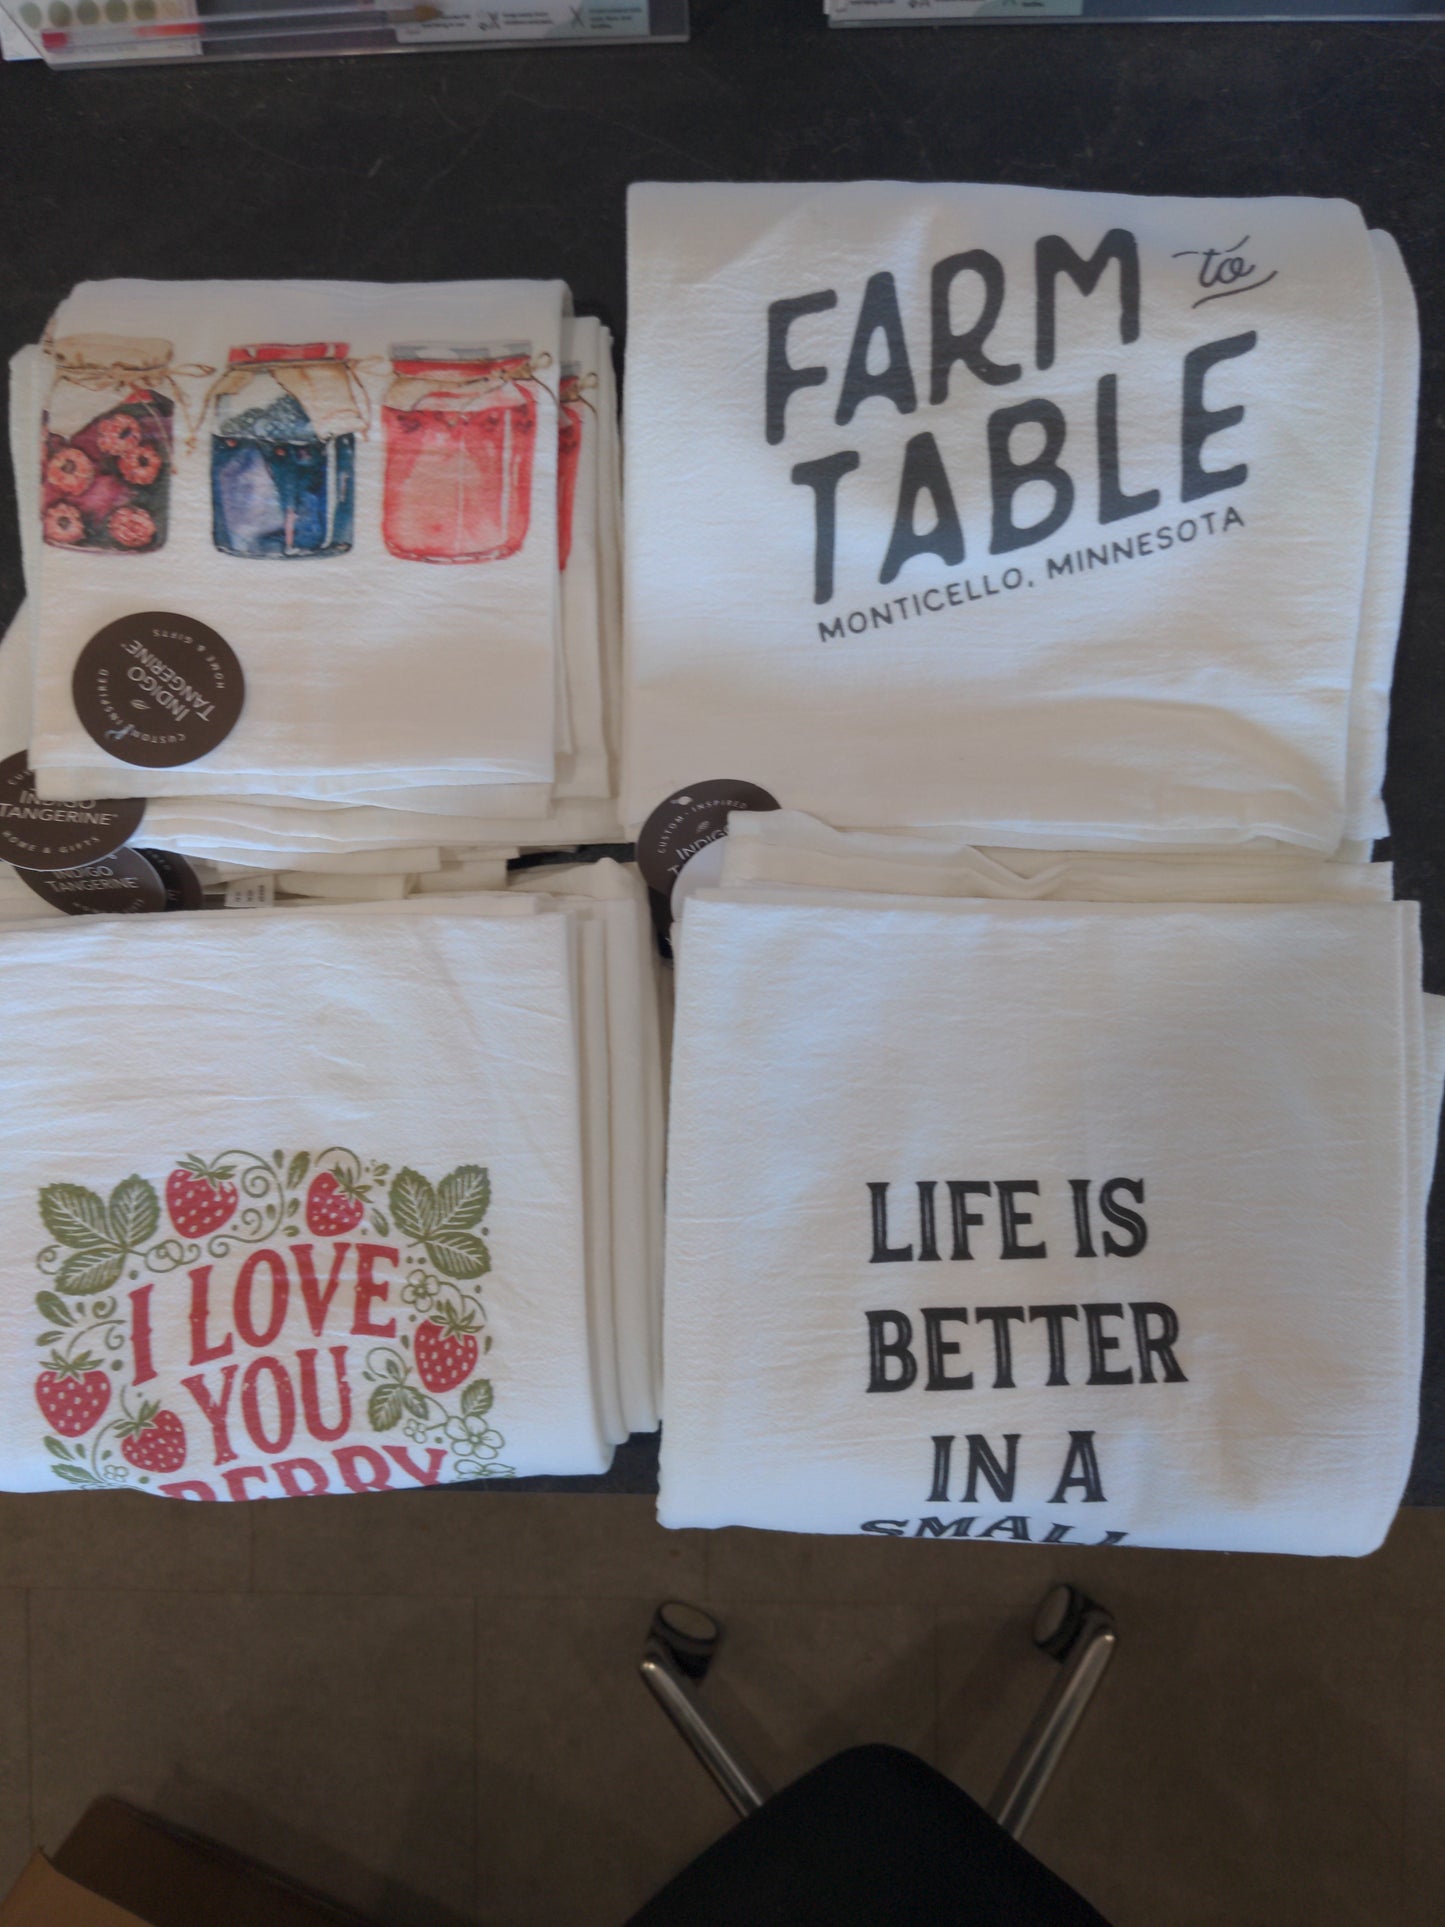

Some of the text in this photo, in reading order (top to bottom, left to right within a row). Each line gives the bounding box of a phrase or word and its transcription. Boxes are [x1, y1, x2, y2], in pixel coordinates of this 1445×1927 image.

[766, 228, 1140, 446] FARM
[790, 330, 1258, 606] TABLE
[1046, 506, 1245, 580] MINNESOTA
[151, 628, 194, 644] GIFTS
[97, 668, 124, 725] INSPIRED
[127, 666, 191, 722] INDIGO
[58, 836, 101, 854] GIFTS
[656, 799, 749, 854] CUSTOM INSPIRED
[865, 1177, 1149, 1264] LIFE IS
[128, 1241, 399, 1387] I LOVE
[864, 1301, 1190, 1394] BETTER
[181, 1345, 352, 1467] YOU
[925, 1430, 1109, 1504] IN A
